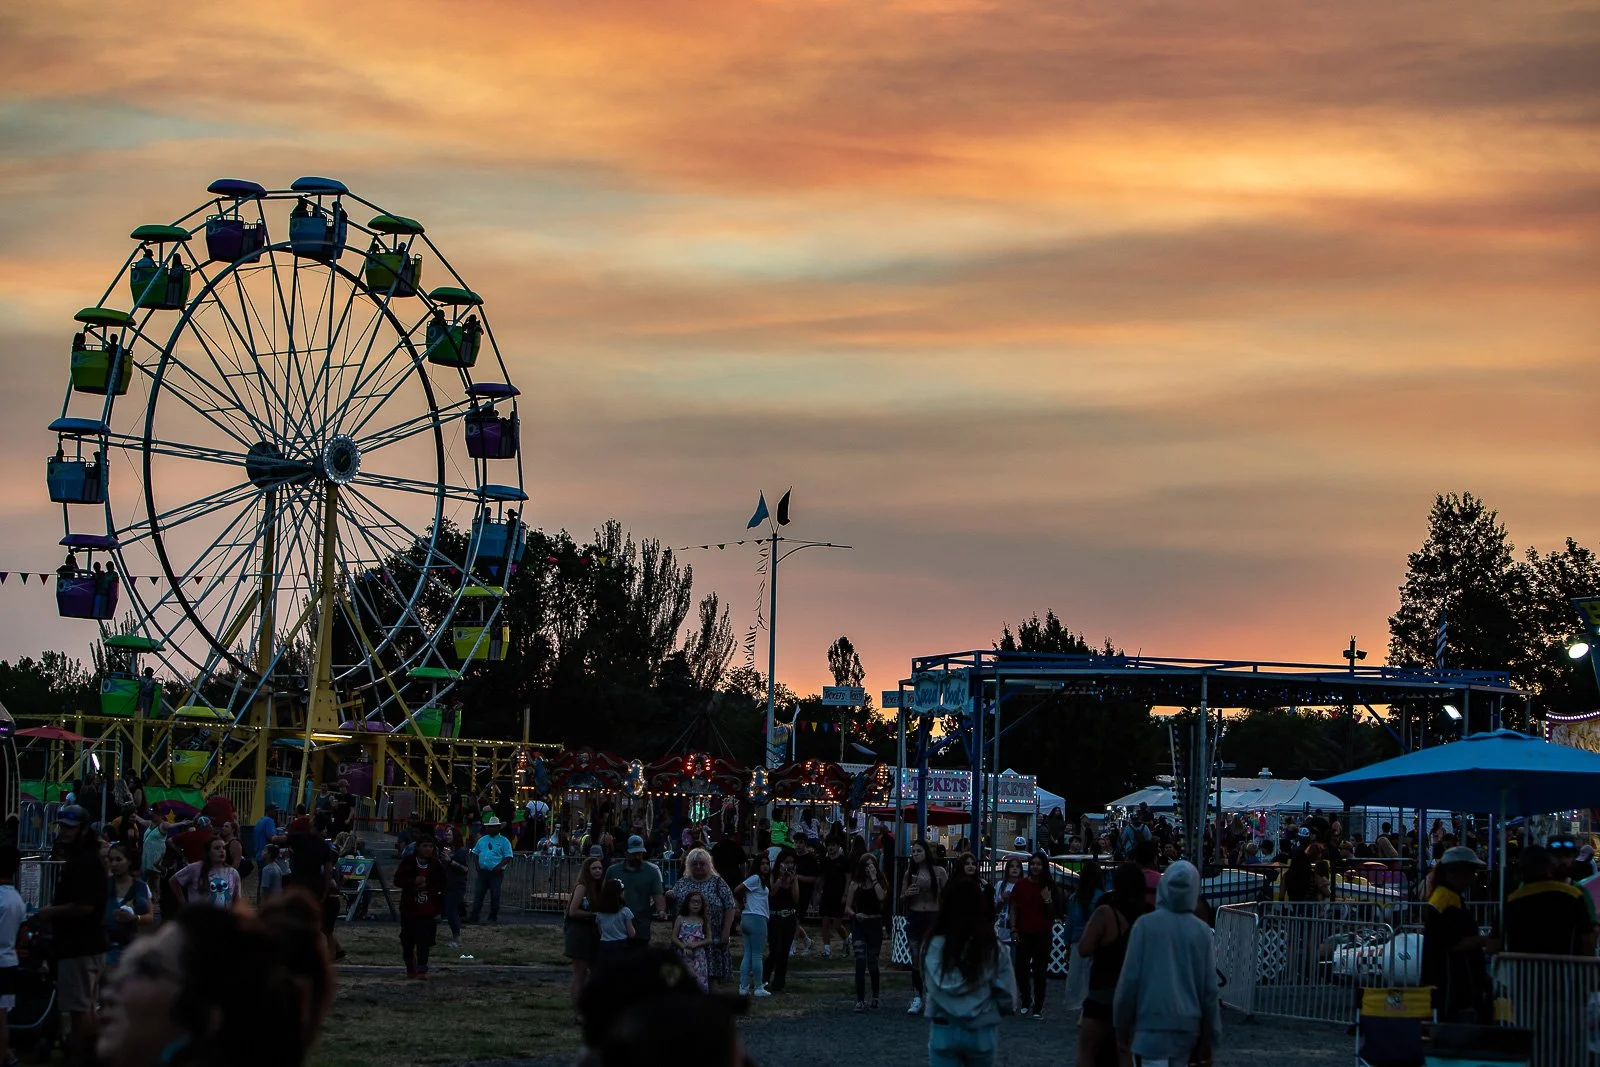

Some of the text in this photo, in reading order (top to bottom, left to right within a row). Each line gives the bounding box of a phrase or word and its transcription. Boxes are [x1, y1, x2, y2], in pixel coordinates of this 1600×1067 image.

[824, 689, 846, 701] TICKETS
[883, 694, 899, 705] TICKE
[944, 682, 966, 706] Boats
[911, 777, 968, 793] TCKETS
[984, 780, 1033, 796] IKETS
